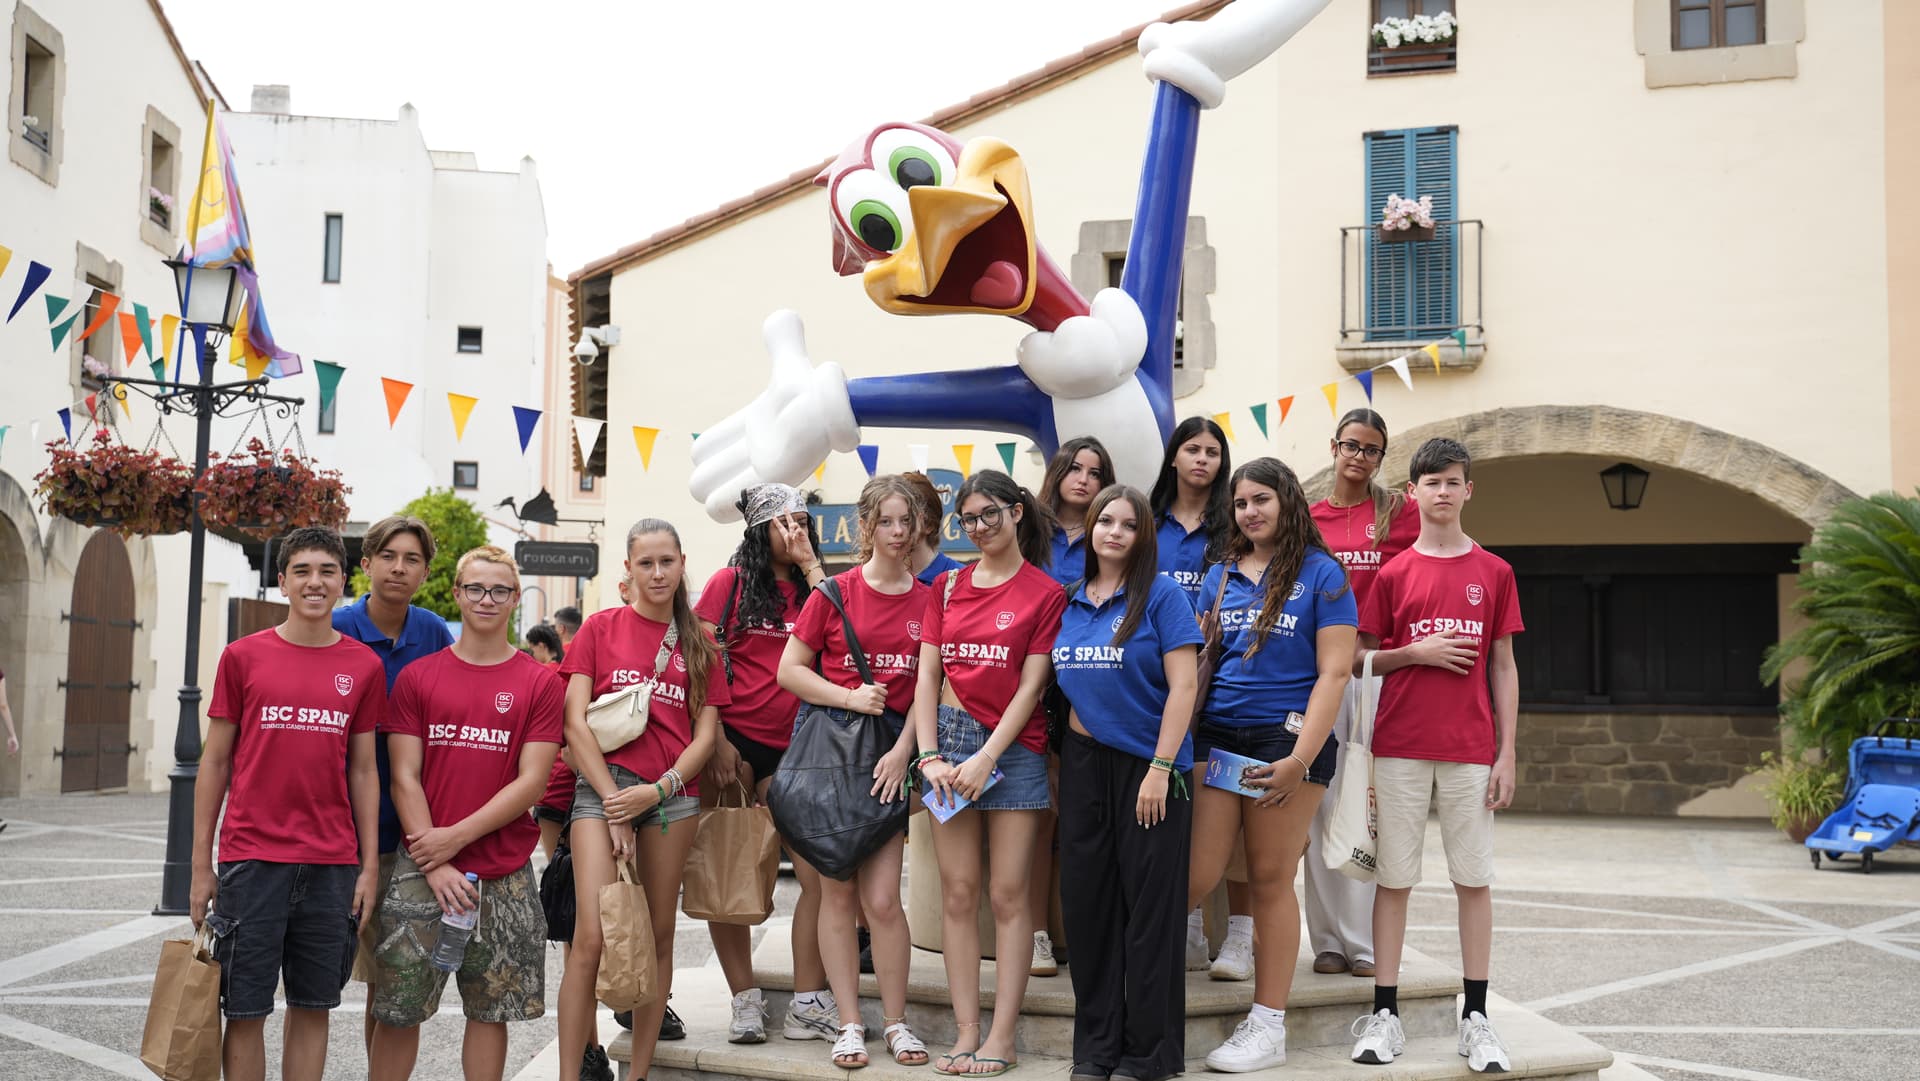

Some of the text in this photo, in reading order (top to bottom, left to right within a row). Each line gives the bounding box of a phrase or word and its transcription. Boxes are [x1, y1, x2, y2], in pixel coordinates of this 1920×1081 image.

[815, 515, 851, 544] LA
[1434, 617, 1483, 635] SPAIN
[959, 643, 1010, 660] SPAIN
[1075, 646, 1124, 662] SPAIN
[612, 669, 640, 684] ISC
[261, 706, 349, 728] ISC SPAIN
[428, 724, 511, 744] ISC SPAIN
